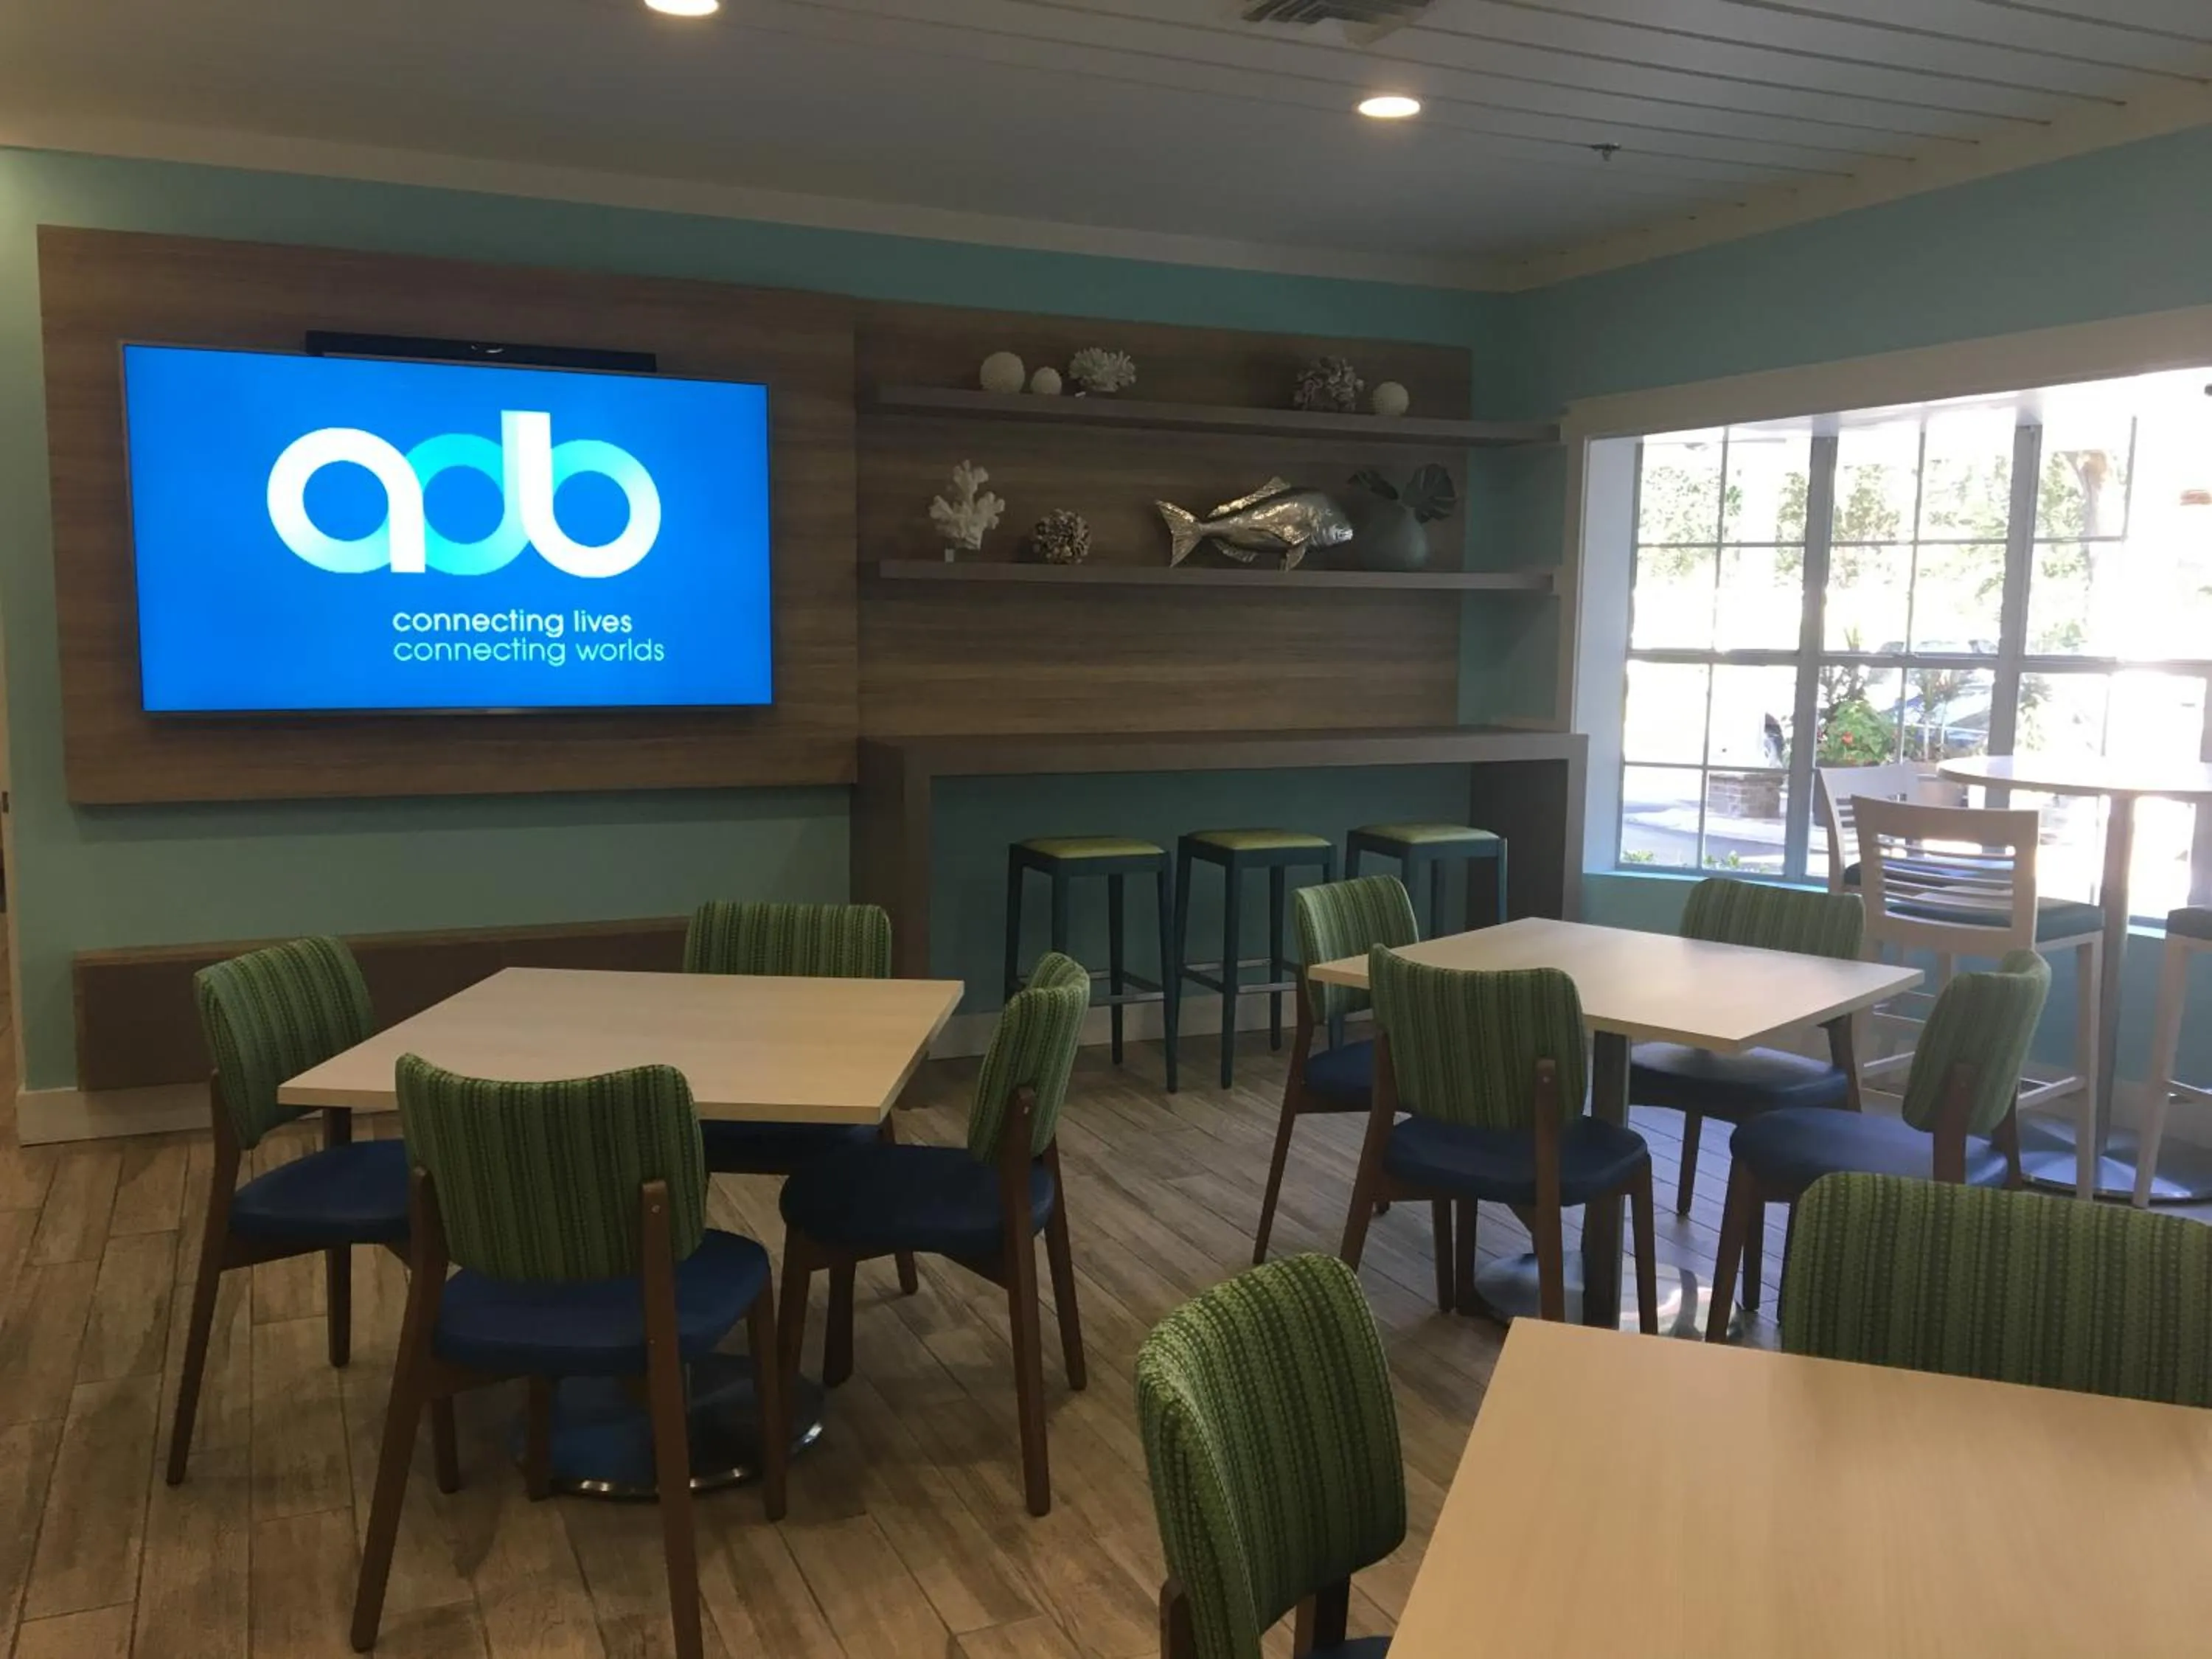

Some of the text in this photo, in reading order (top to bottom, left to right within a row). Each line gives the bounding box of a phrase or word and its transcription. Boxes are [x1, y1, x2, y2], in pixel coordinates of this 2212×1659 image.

[392, 609, 633, 638] connecting lives
[392, 637, 665, 667] connecting worlds
